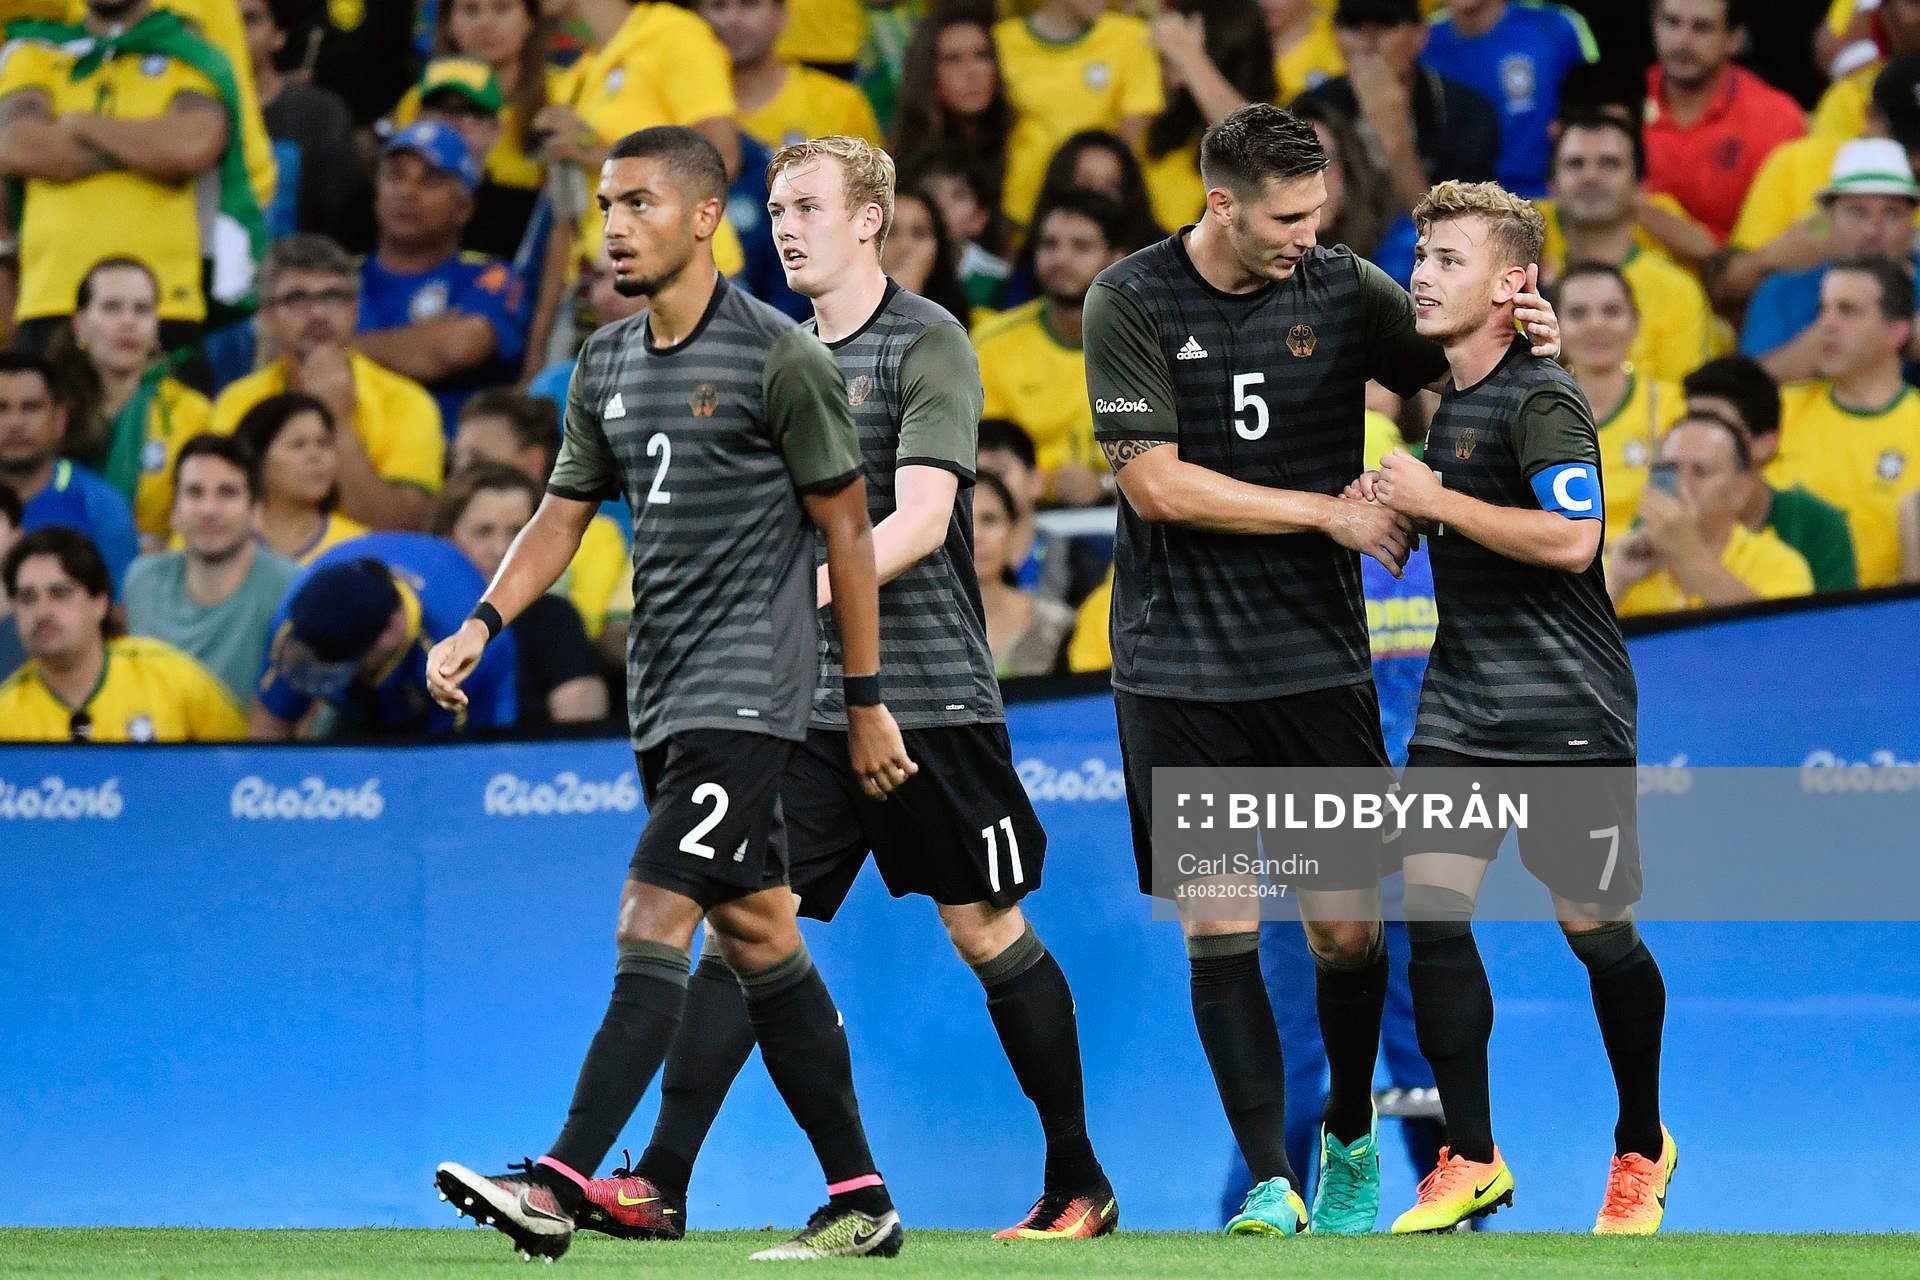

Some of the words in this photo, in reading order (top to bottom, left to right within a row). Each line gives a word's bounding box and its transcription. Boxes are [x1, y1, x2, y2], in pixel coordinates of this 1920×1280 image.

[1177, 350, 1208, 360] adidas
[1234, 372, 1270, 440] 5
[647, 432, 671, 504] 2
[1552, 467, 1592, 512] C
[0, 776, 124, 819] io2016
[230, 776, 384, 819] Rio2016
[484, 771, 640, 816] Rio2016
[1017, 758, 1124, 801] Rio20
[679, 782, 729, 860] 2
[982, 816, 1024, 893] 11
[1589, 824, 1619, 891] 7
